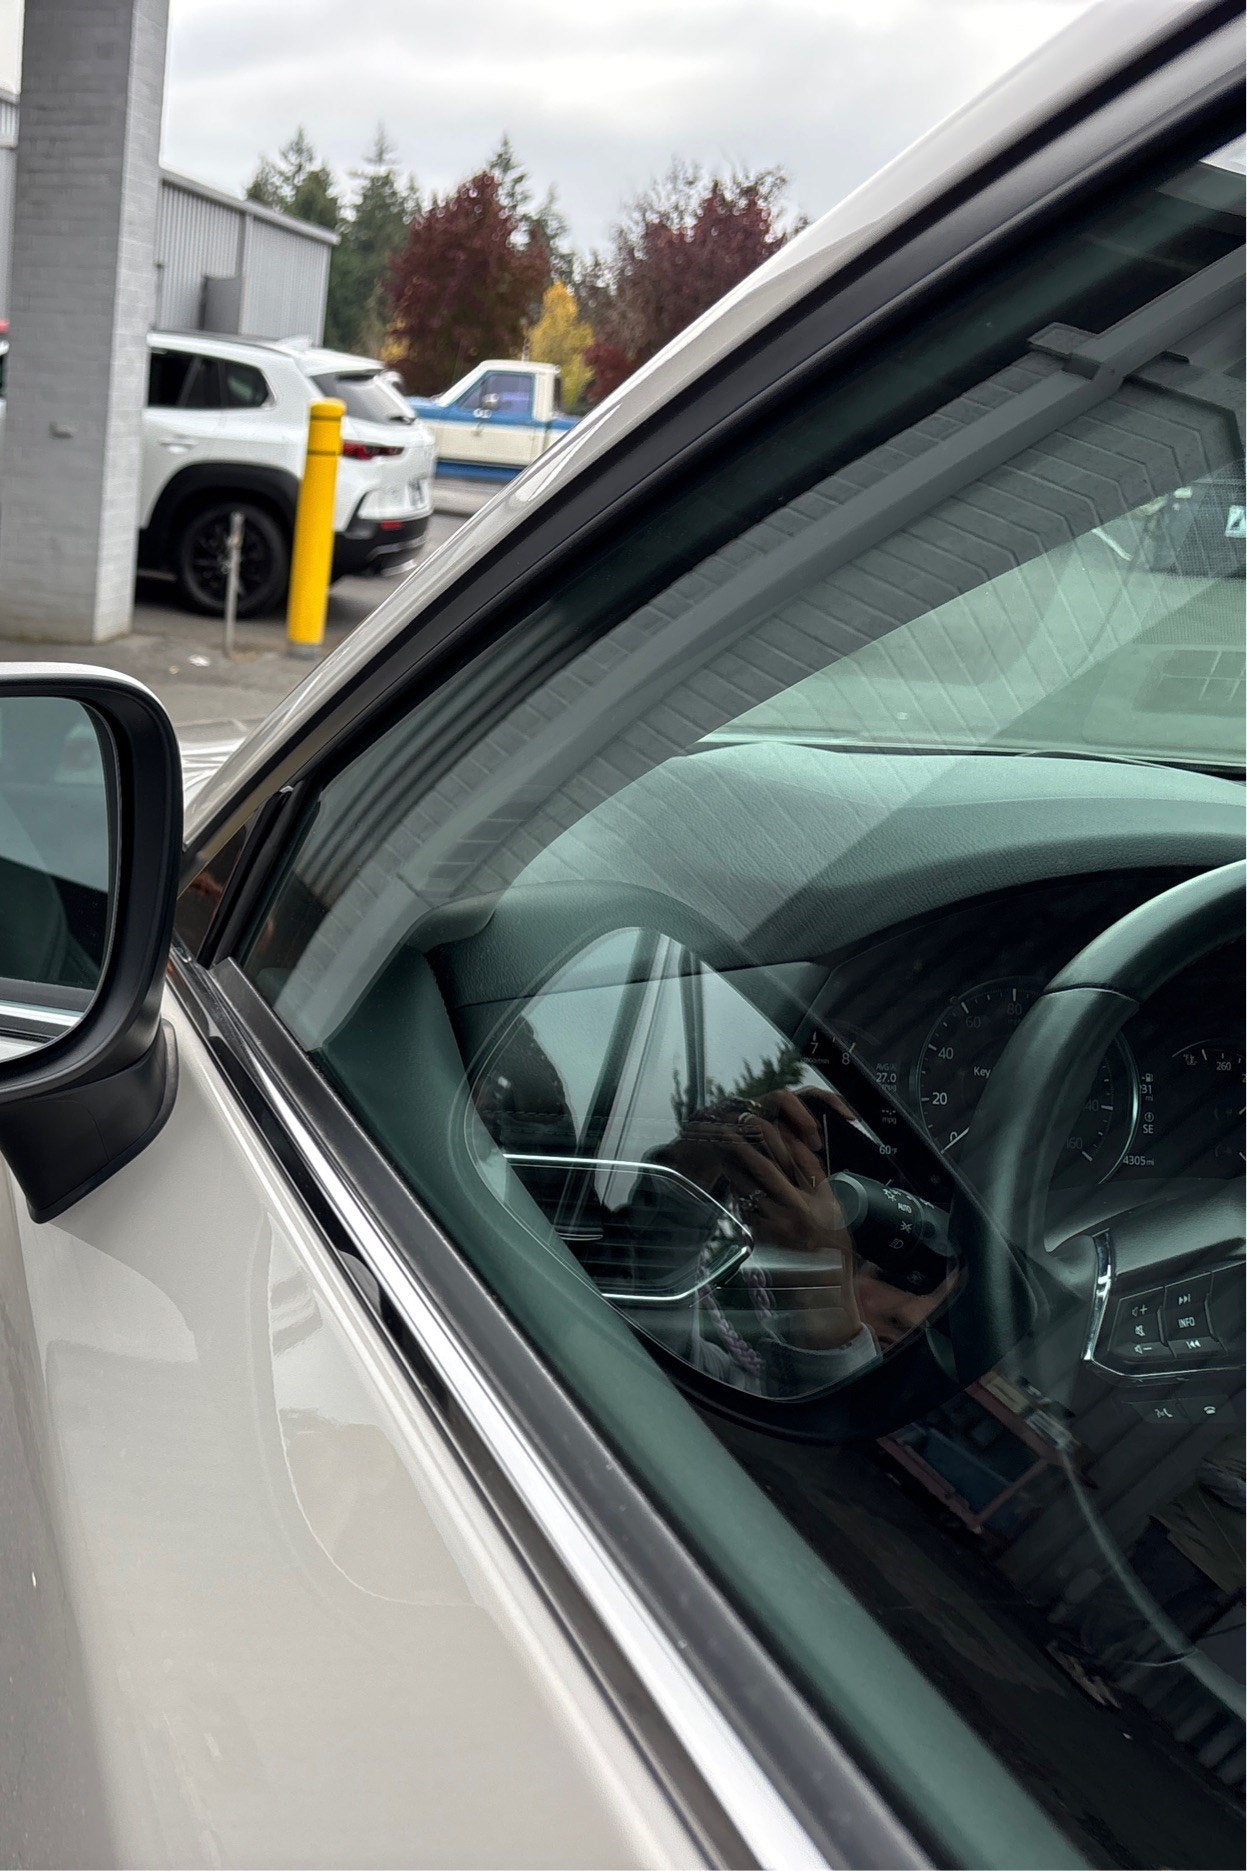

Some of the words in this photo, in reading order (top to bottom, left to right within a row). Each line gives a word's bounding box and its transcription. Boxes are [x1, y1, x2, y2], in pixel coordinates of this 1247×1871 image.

[841, 1052, 850, 1066] 8
[938, 1047, 954, 1060] 40
[1216, 1061, 1232, 1071] 260
[875, 1072, 897, 1083] 27.0
[973, 1066, 991, 1079] Key
[932, 1092, 948, 1105] 20
[1083, 1098, 1099, 1112] 40
[1143, 1124, 1154, 1134] SE
[898, 1203, 912, 1213] AUTO
[1178, 1317, 1196, 1328] INFO
